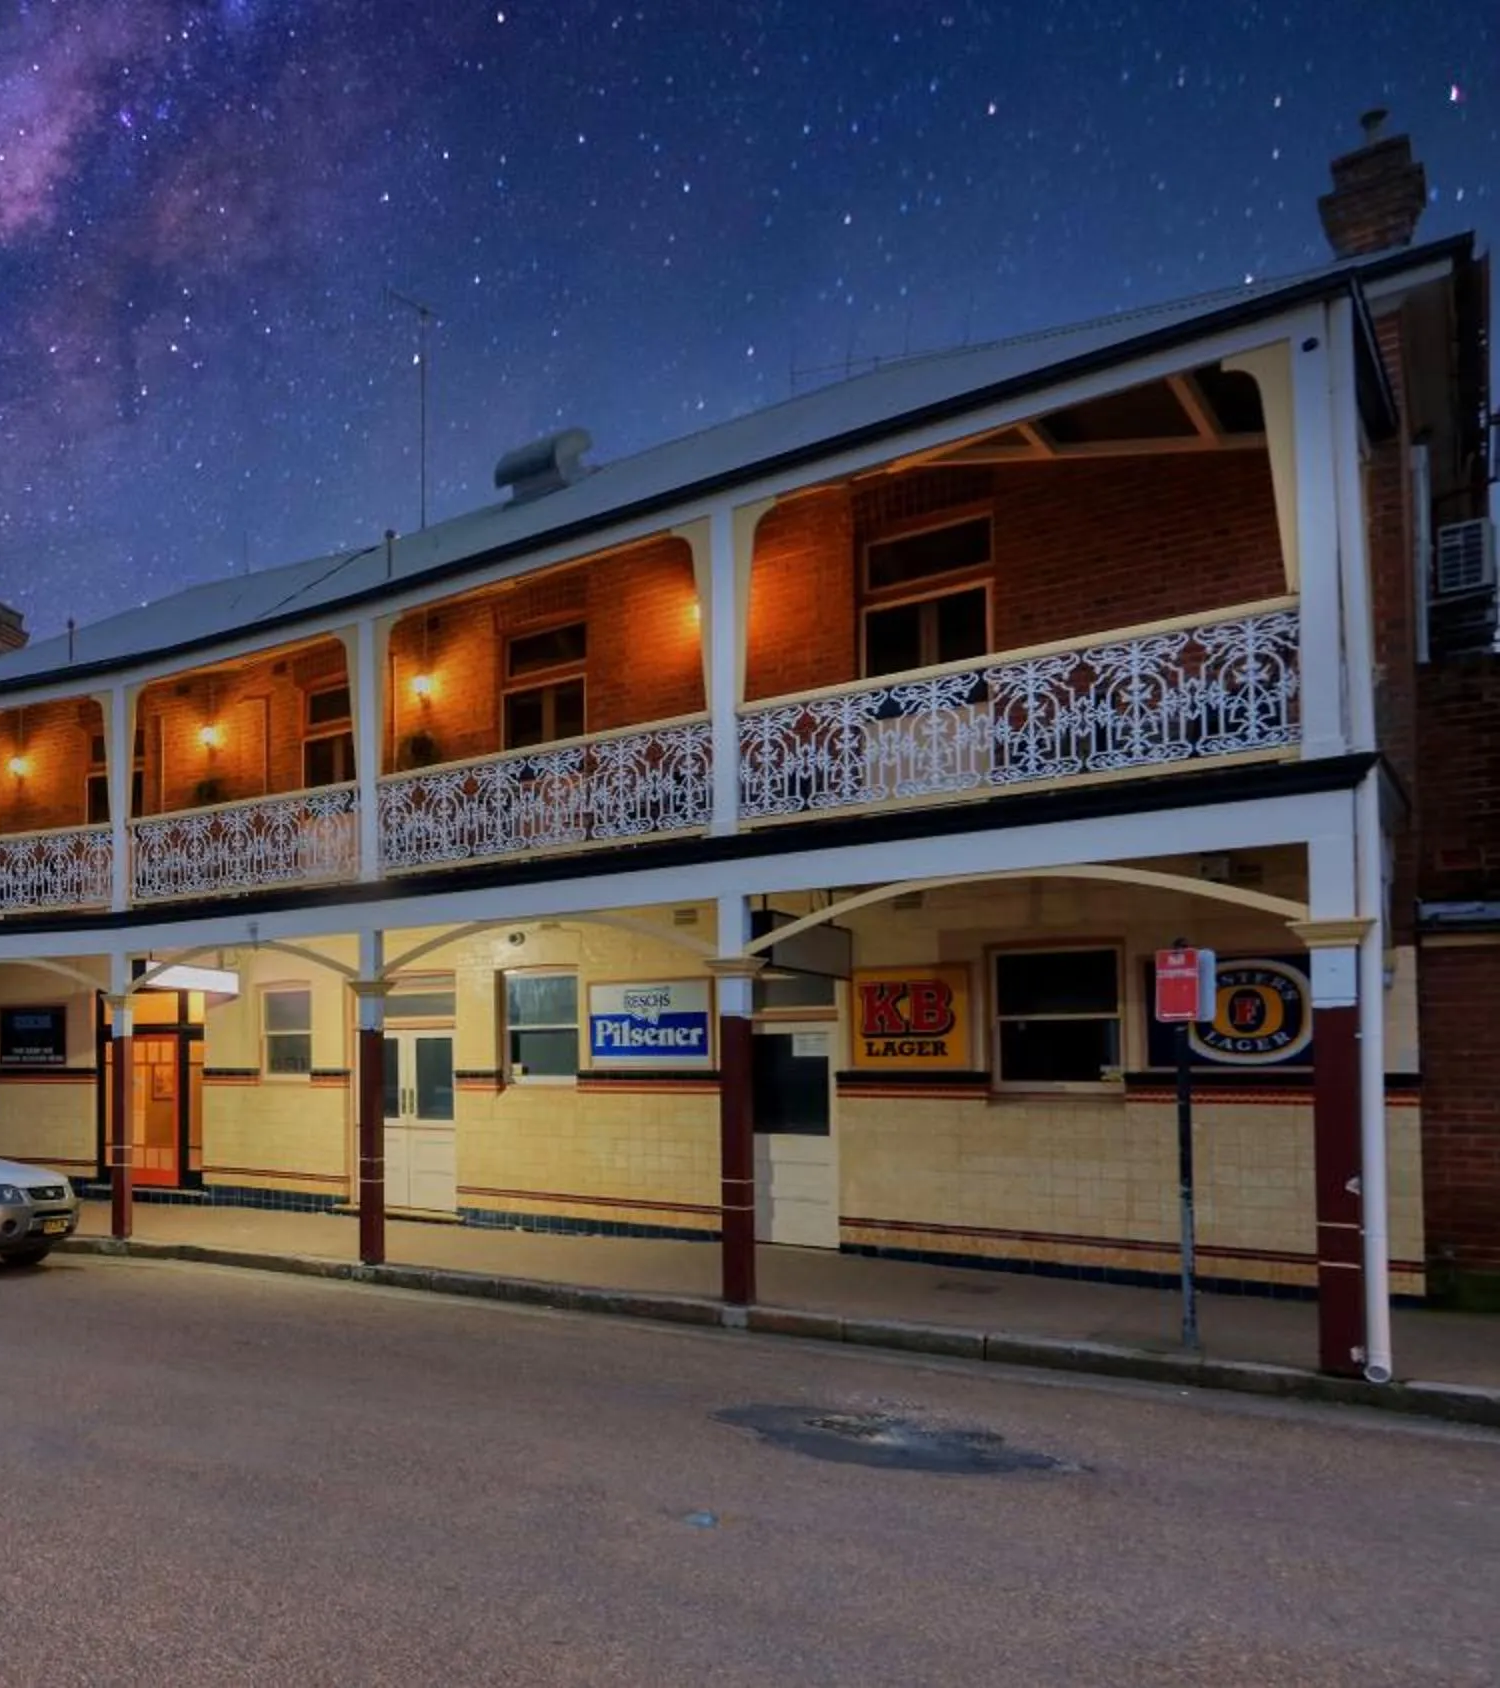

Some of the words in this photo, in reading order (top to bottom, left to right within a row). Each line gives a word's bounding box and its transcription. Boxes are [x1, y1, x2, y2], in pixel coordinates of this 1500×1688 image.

[860, 981, 956, 1038] KB
[595, 1018, 703, 1047] Pilsener
[1203, 1031, 1291, 1051] LAGER
[865, 1041, 949, 1057] LAGER
